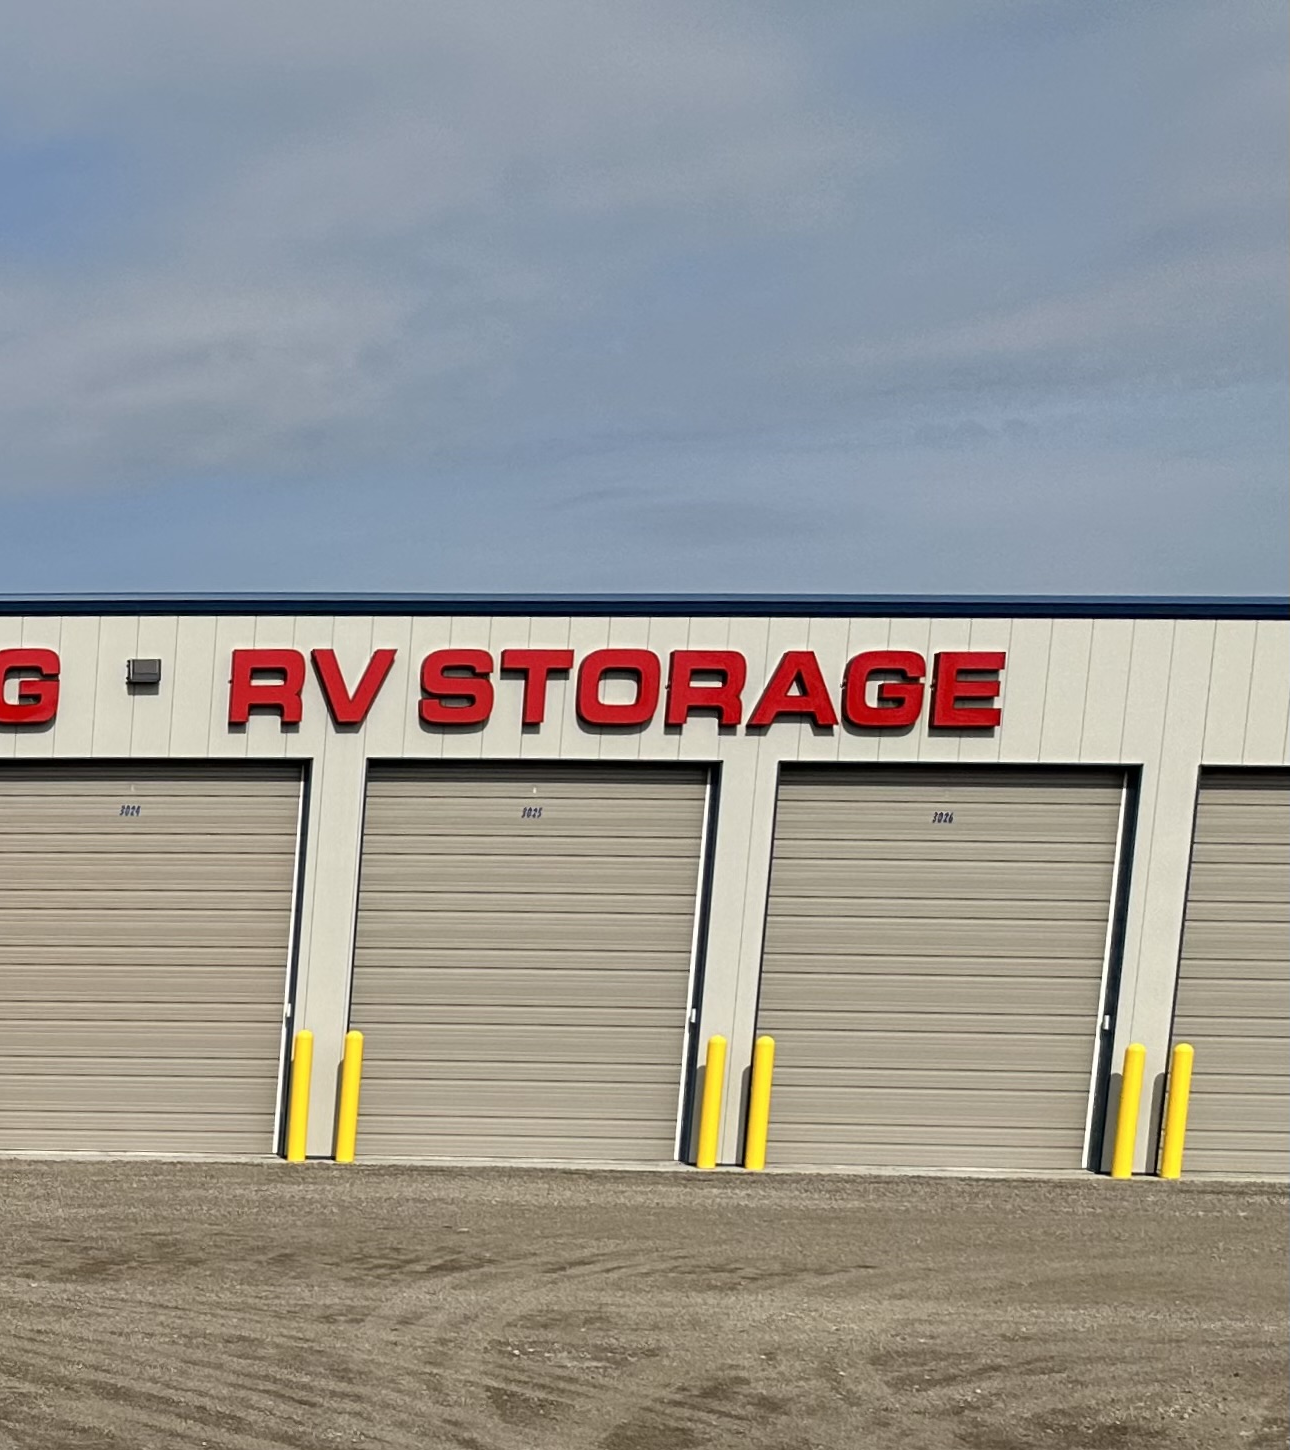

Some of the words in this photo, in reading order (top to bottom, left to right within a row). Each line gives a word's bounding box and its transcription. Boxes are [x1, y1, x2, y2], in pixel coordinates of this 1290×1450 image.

[228, 648, 397, 724] RV
[417, 648, 1007, 728] STORAGE
[932, 811, 954, 824] 3026
